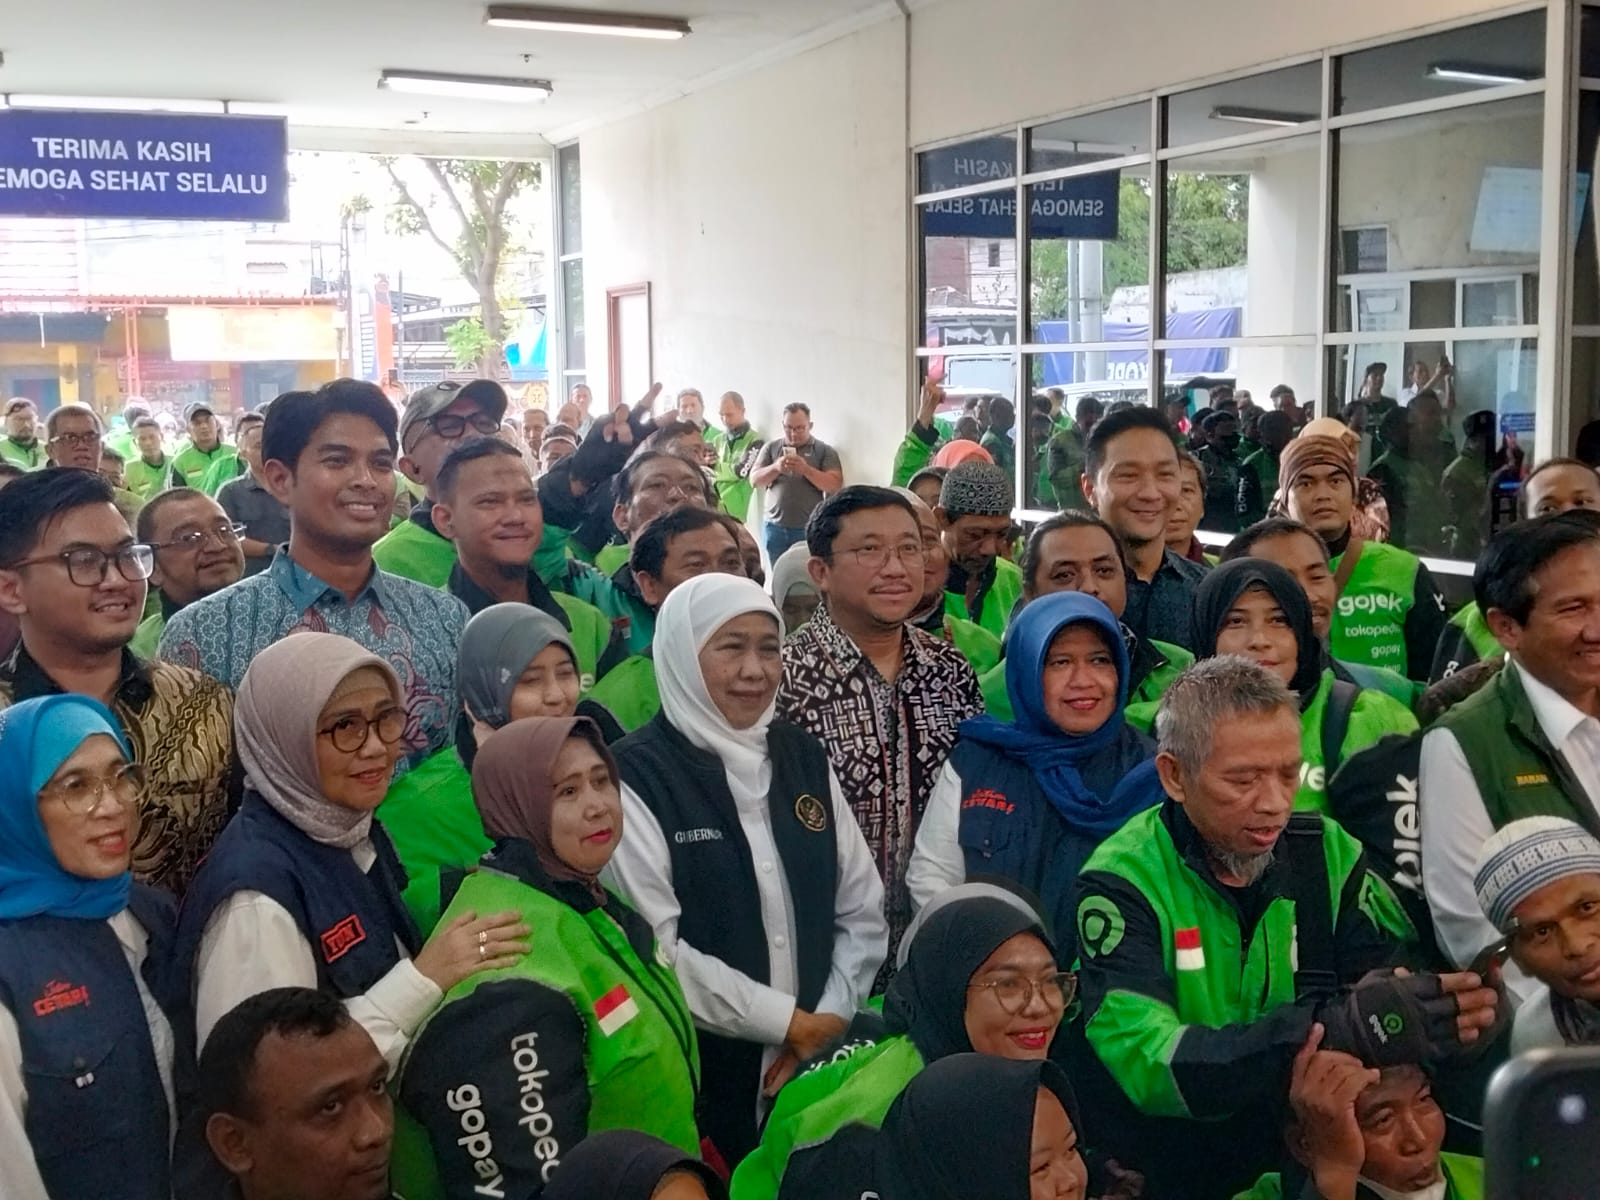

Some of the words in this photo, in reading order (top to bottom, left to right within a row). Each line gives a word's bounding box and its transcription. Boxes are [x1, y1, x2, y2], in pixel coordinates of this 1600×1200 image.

[31, 137, 129, 160] TERIMA
[137, 141, 211, 162] KASIH
[0, 168, 84, 189] EMOGA
[90, 170, 170, 191] SEHAT
[176, 172, 267, 194] SELALU
[1337, 591, 1403, 617] gojek
[446, 1084, 505, 1198] gopay
